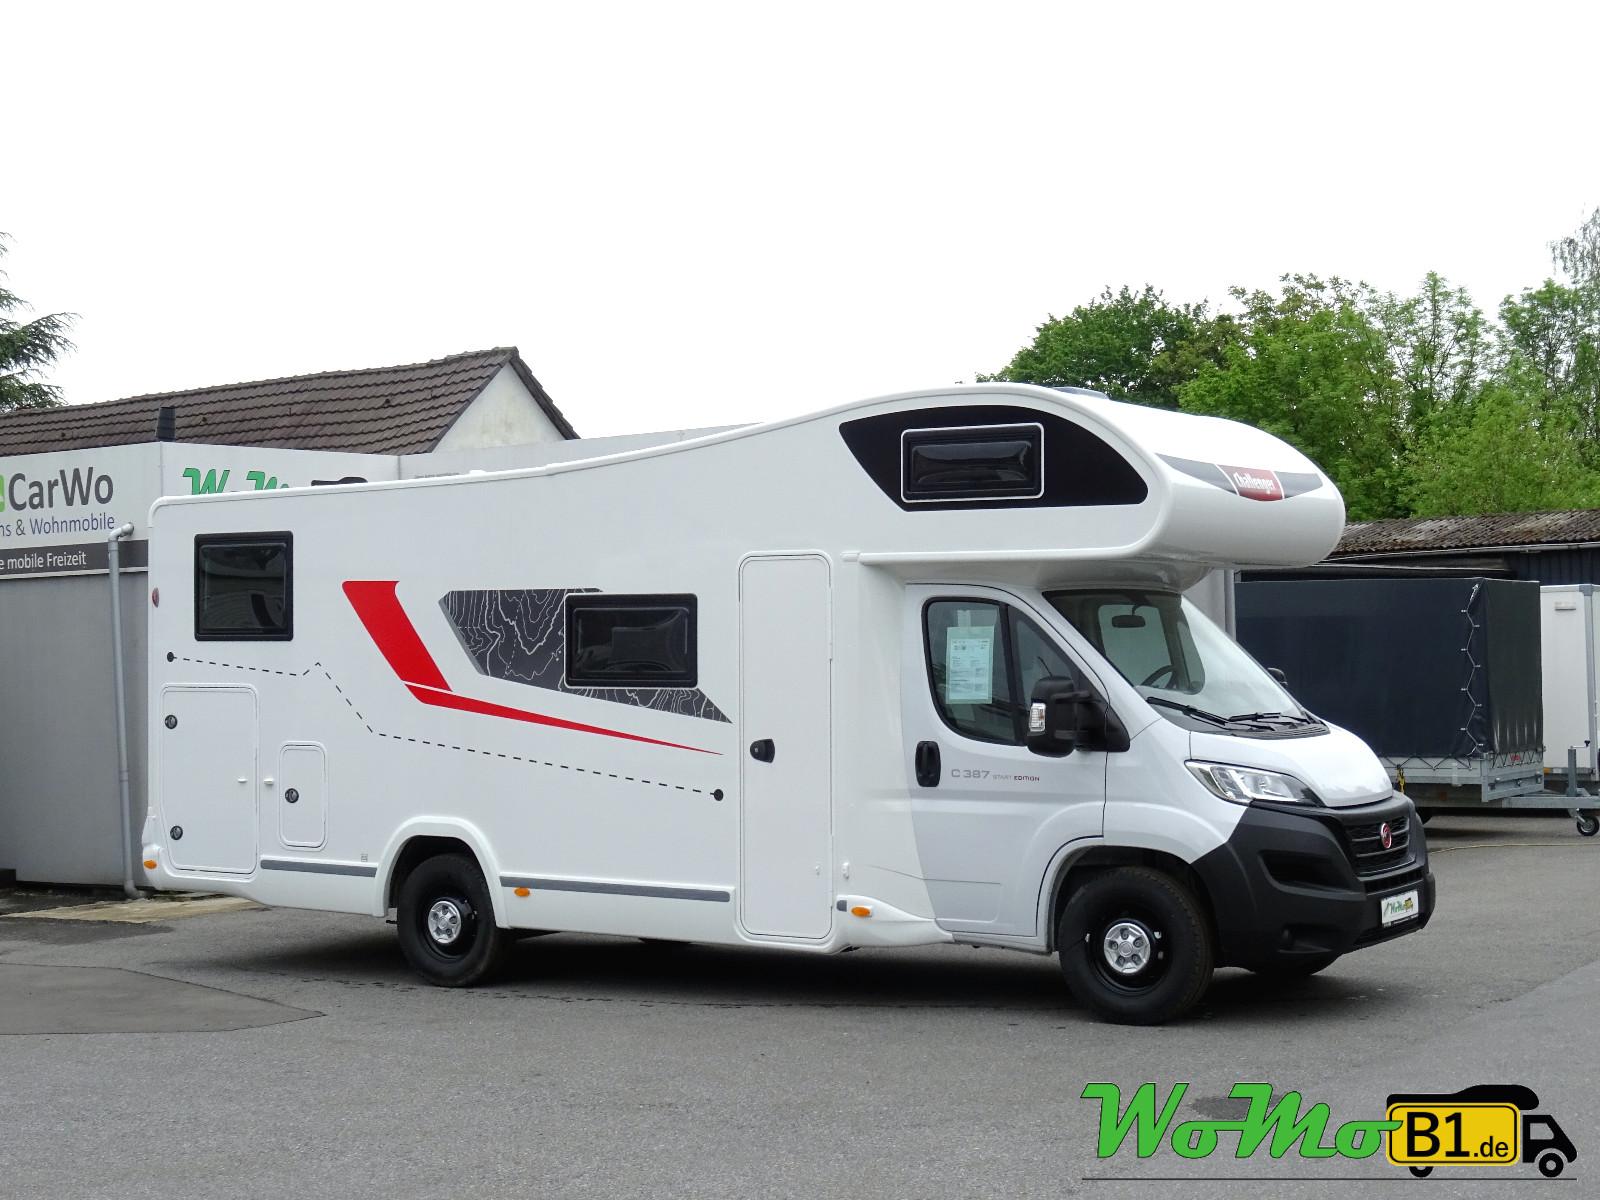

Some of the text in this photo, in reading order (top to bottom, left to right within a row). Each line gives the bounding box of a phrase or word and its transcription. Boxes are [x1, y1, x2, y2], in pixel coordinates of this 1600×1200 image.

[8, 467, 114, 511] CarWo
[15, 519, 26, 536] &
[29, 512, 115, 535] Wohnmobile
[7, 553, 44, 570] mobile
[46, 550, 87, 567] Freizeit
[951, 769, 961, 778] C
[962, 769, 991, 779] 387
